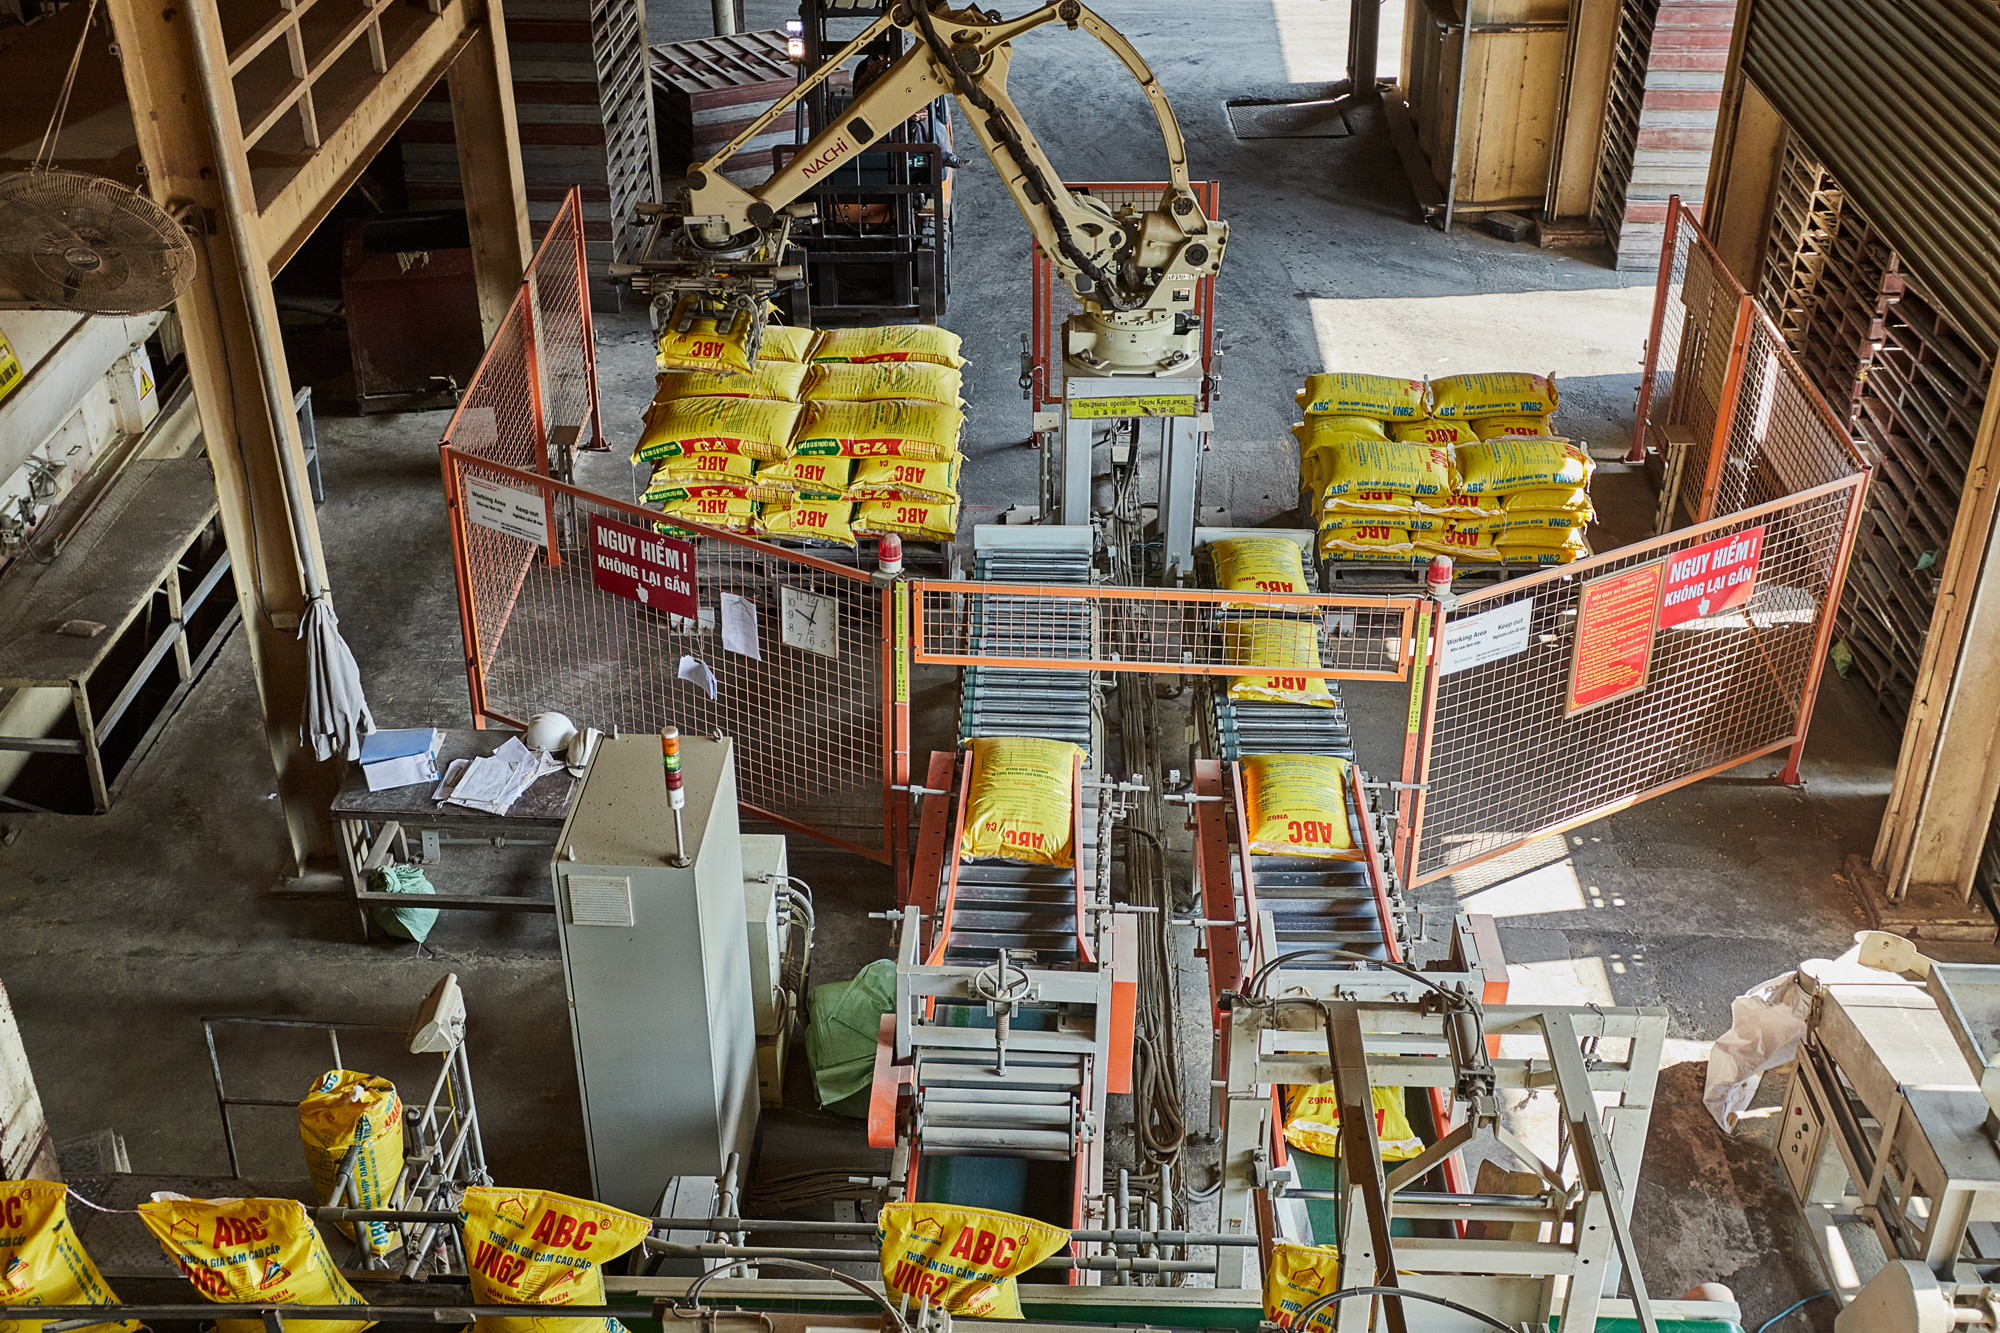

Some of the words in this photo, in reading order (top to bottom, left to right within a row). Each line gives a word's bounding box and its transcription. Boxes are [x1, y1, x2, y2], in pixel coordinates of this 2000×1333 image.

[801, 137, 848, 178] NACHI
[1156, 398, 1171, 406] Keep
[1312, 401, 1329, 411] ABC
[1392, 406, 1414, 417] VN62
[1440, 407, 1455, 417] ABC
[1520, 402, 1543, 412] VN62
[853, 442, 888, 455] C4
[697, 456, 728, 471] ABC
[794, 463, 825, 482] ABC
[893, 465, 926, 483] ABC
[1331, 484, 1348, 495] ABC
[1415, 484, 1438, 495] VN62
[1466, 483, 1484, 493] ABC
[471, 490, 494, 504] Working
[494, 498, 506, 507] Area
[515, 505, 529, 515] Keep
[529, 509, 539, 517] out
[697, 500, 728, 513] ABC
[797, 510, 828, 528] ABC
[897, 507, 928, 525] ABC
[1548, 518, 1572, 528] VN62
[1326, 521, 1343, 530] ABC
[1410, 520, 1433, 530] VN62
[597, 525, 636, 557] NGUY
[1537, 554, 1560, 562] VN62
[1669, 552, 1711, 584] NGUY
[1711, 535, 1757, 570] HIỂM!
[597, 554, 639, 579] KHÔNG
[642, 568, 661, 587] LẠI
[664, 574, 690, 596] GẦN
[1637, 577, 1653, 586] ROBOT
[1664, 581, 1705, 607] KHÔNG
[1706, 575, 1726, 593] LẠI
[1728, 565, 1753, 586] GẦN
[788, 610, 794, 619] 9
[788, 623, 794, 632] 8
[1420, 618, 1428, 643] Equipment
[1497, 621, 1513, 631] Keep
[797, 633, 803, 642] 7
[809, 636, 815, 646] 6
[1446, 634, 1473, 646] Working
[1473, 629, 1487, 638] Area
[986, 822, 997, 831] C4
[1288, 821, 1332, 843] ABC
[1005, 830, 1044, 849] ABC
[1308, 1096, 1333, 1105] VN62
[358, 1157, 369, 1178] DẠNG
[361, 1179, 371, 1194] HỢP
[503, 1216, 526, 1230] VIETNAM
[920, 1236, 942, 1247] VIETNAM
[210, 1254, 225, 1268] GIA
[249, 1249, 264, 1261] CAO
[265, 1243, 280, 1257] CẤP
[489, 1229, 508, 1248] THỨC
[507, 1239, 519, 1254] ĂN
[520, 1246, 533, 1260] GIA
[555, 1254, 573, 1267] CAO
[574, 1257, 592, 1271] CẤP
[473, 1240, 526, 1289] VN62
[906, 1250, 926, 1266] THỨC
[925, 1257, 938, 1271] ĂN
[939, 1263, 954, 1276] GIA
[975, 1272, 993, 1283] CAO
[892, 1260, 948, 1306] VN62
[268, 1288, 288, 1303] VIÊN
[549, 1291, 569, 1304] VIÊN
[1298, 1286, 1321, 1297] VIETNAM
[972, 1302, 991, 1315] VIÊN
[1280, 1298, 1303, 1313] THỨC
[1316, 1312, 1332, 1327] GIA
